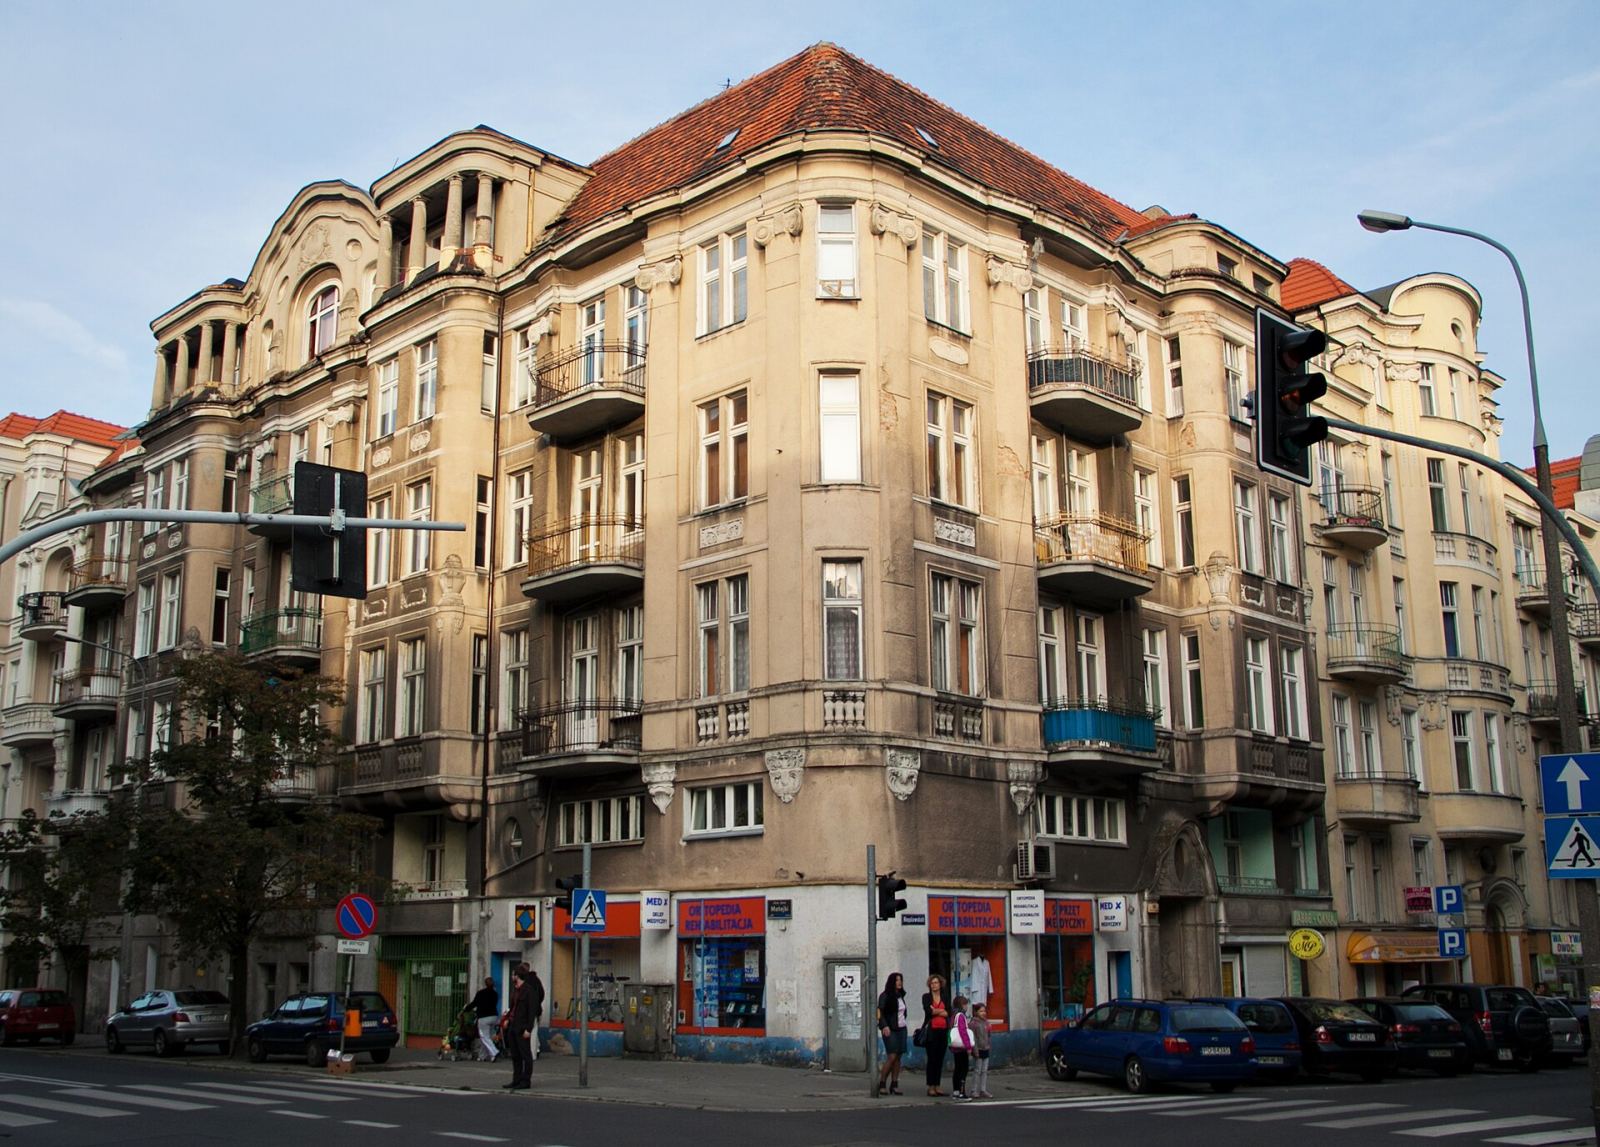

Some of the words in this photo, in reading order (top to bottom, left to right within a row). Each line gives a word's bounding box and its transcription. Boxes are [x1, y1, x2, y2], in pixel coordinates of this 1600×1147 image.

[646, 897, 662, 906] MED
[1441, 888, 1457, 911] P
[689, 904, 741, 916] ORTOPEDIA
[942, 901, 991, 912] ORTOPEDIA
[1100, 902, 1113, 910] MED
[685, 919, 752, 930] REHABILITACJA
[939, 916, 1002, 929] REHABILITACJA
[1046, 918, 1086, 928] MEDYCZNY
[1444, 932, 1460, 954] P
